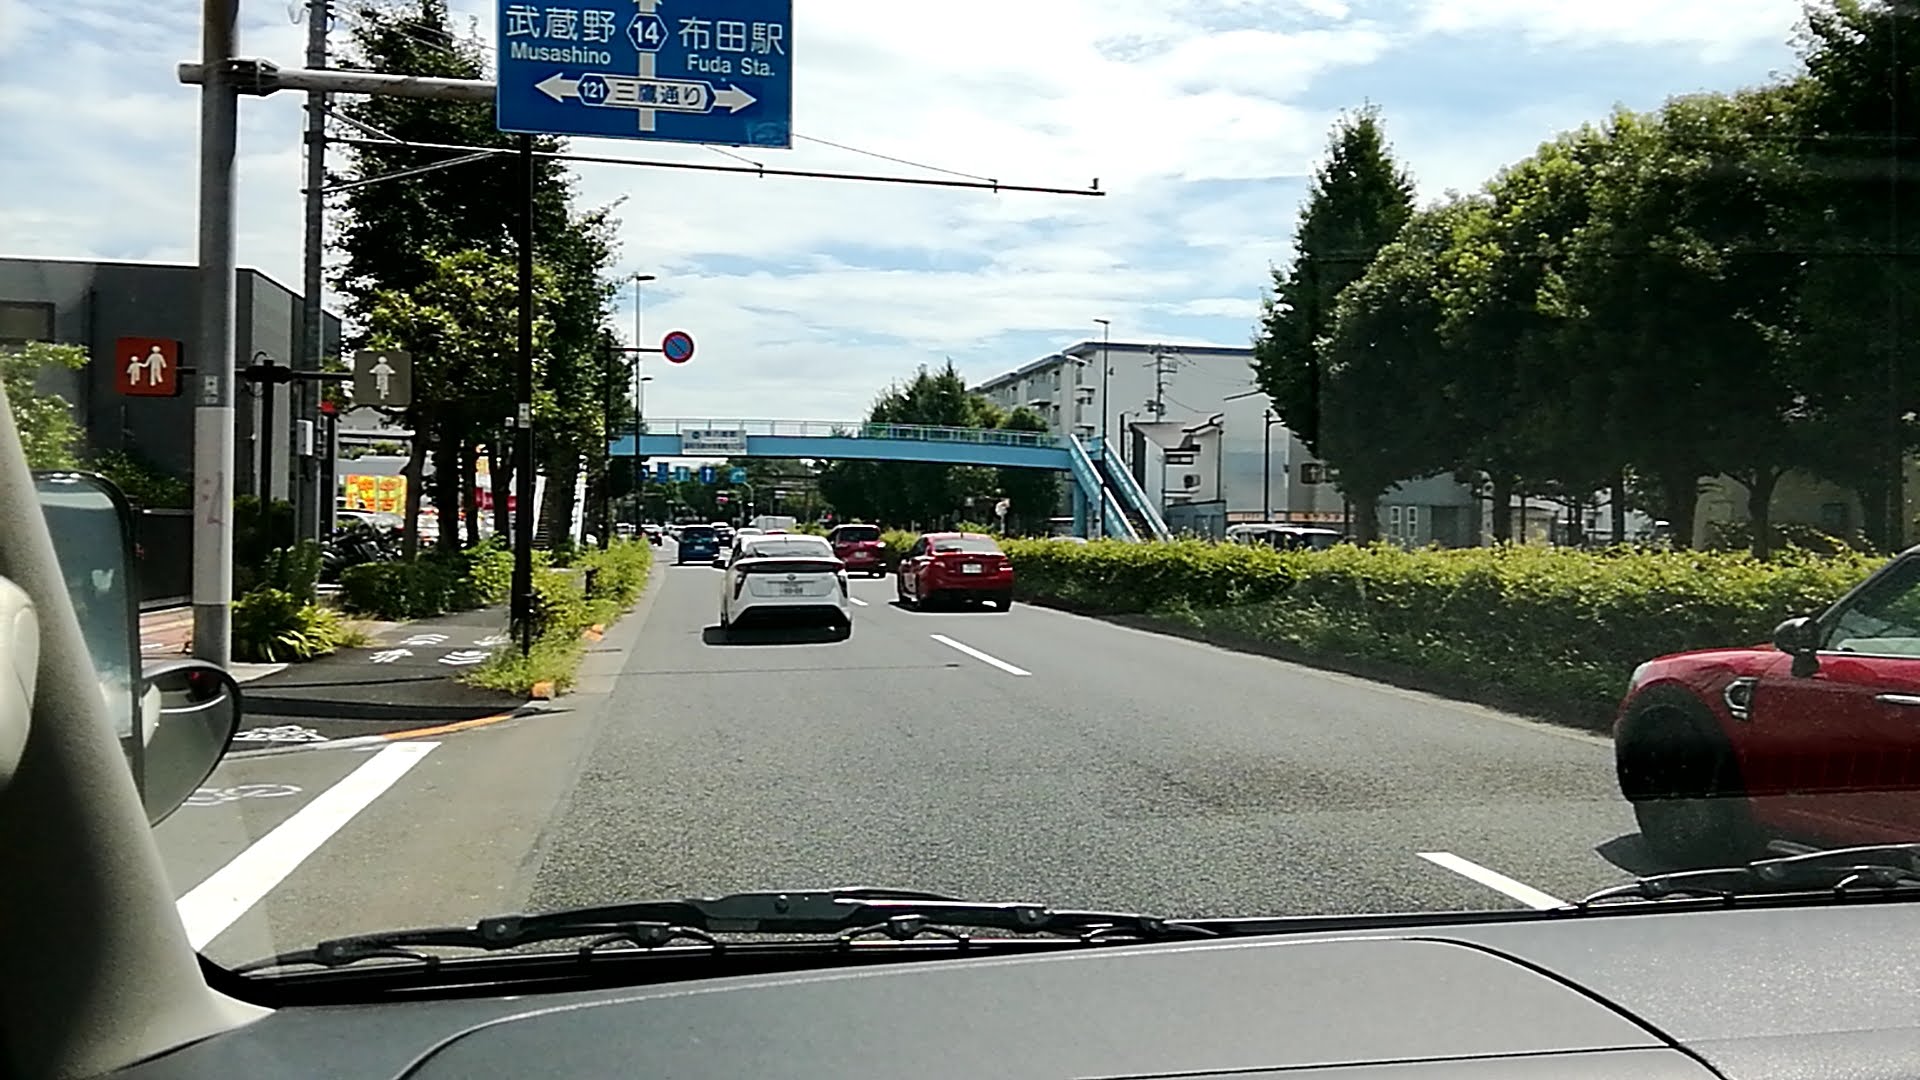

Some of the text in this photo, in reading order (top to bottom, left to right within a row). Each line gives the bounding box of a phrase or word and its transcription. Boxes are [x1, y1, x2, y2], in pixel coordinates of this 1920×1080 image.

[505, 4, 616, 44] 武蔵野
[633, 21, 660, 45] 14
[678, 16, 785, 56] 布田駅
[510, 41, 611, 65] Musashino
[687, 54, 775, 77] Fuda Sta.
[582, 80, 604, 99] 121
